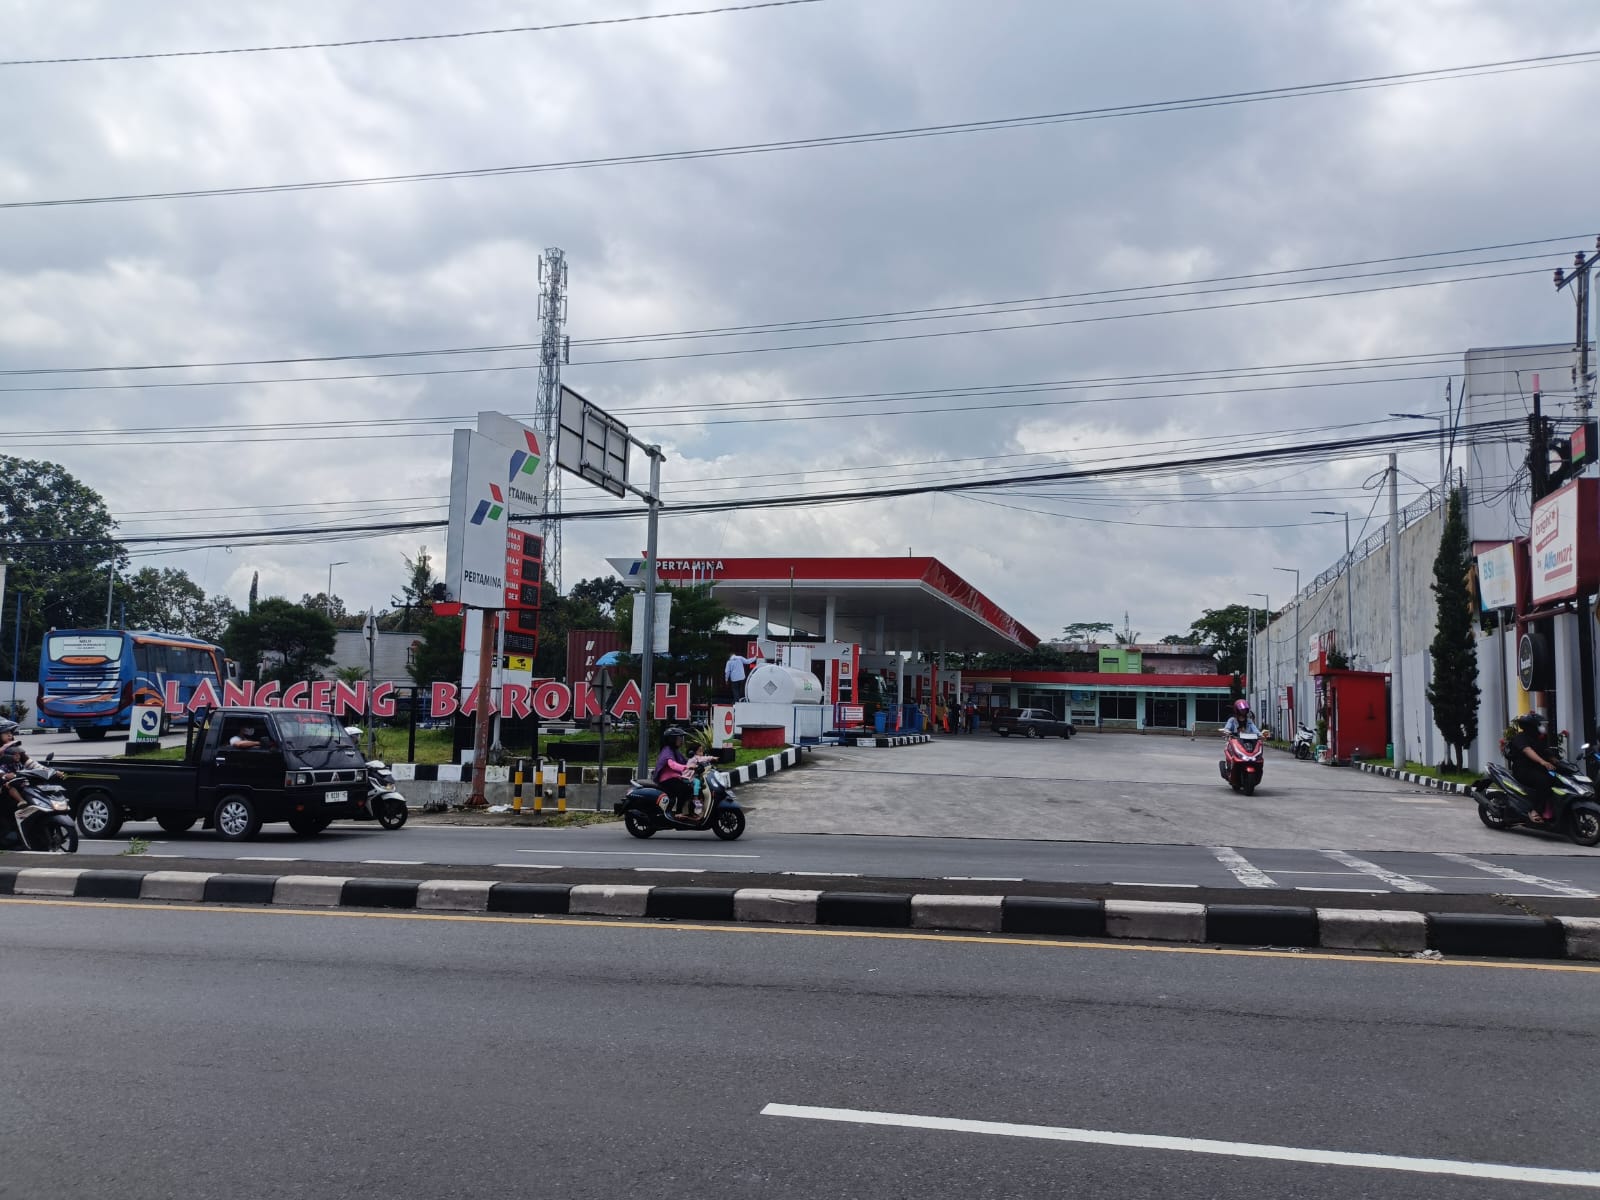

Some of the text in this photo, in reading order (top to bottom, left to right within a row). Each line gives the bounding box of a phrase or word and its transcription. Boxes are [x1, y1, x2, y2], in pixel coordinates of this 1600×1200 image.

[464, 569, 502, 590] PERTAMINA
[655, 560, 724, 571] PERTAMINA
[164, 679, 396, 717] LANGGENG
[430, 679, 691, 720] BAROKAH
